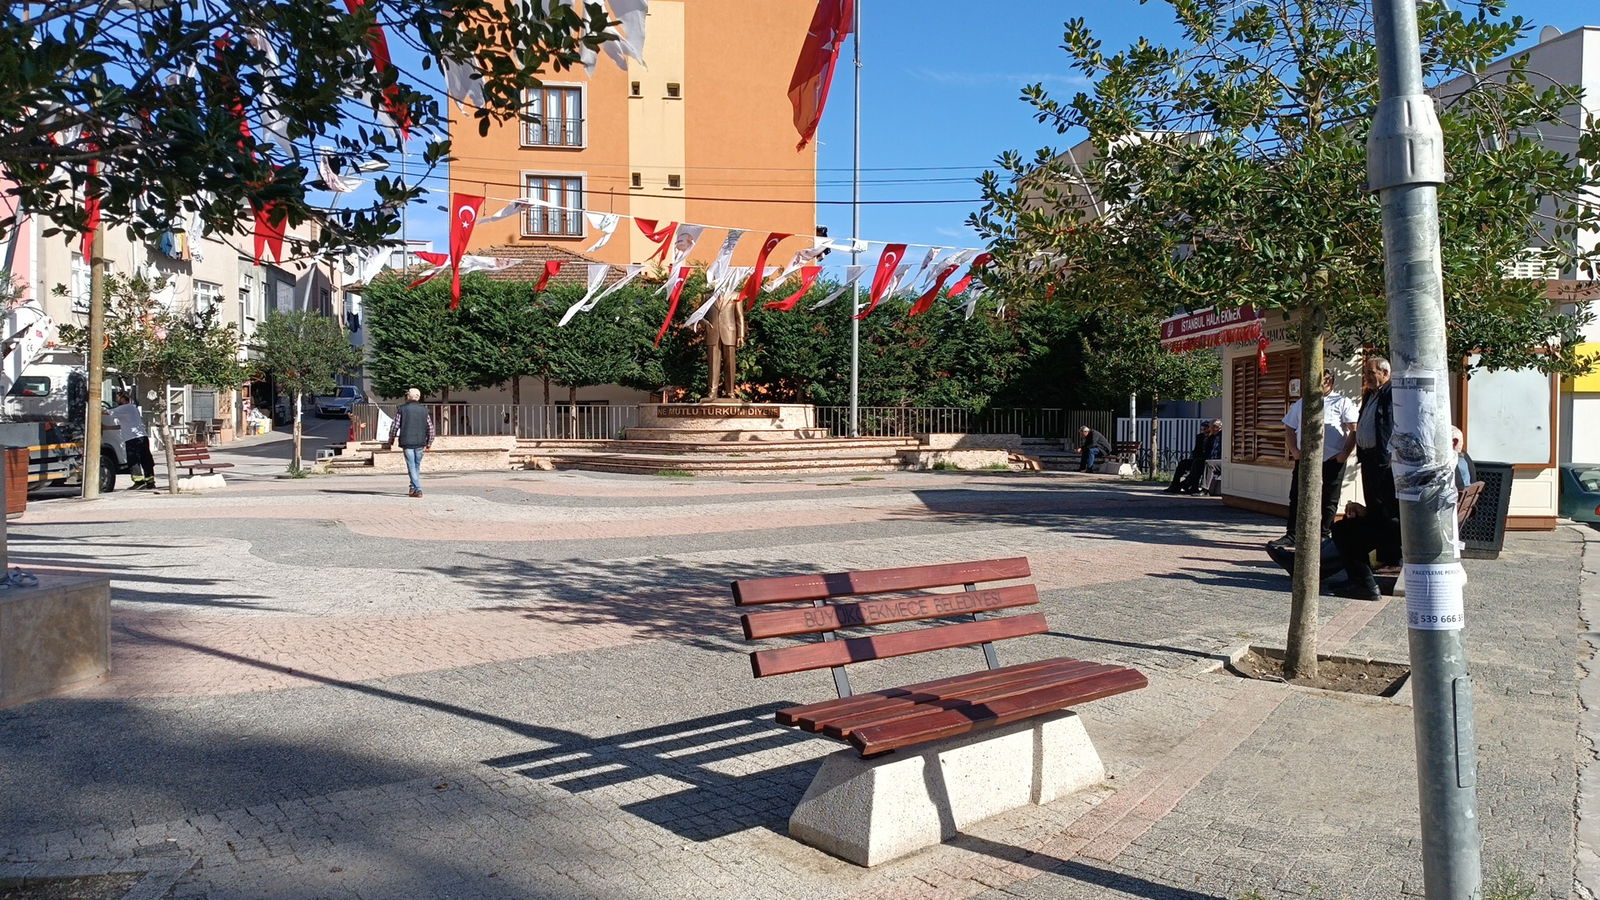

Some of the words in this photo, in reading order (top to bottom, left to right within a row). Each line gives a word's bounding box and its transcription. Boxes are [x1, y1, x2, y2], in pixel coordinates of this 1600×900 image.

[1181, 313, 1206, 333] İSTANBUL
[669, 407, 699, 416] MUTLU
[1420, 615, 1438, 623] 539
[1440, 614, 1457, 623] 666
